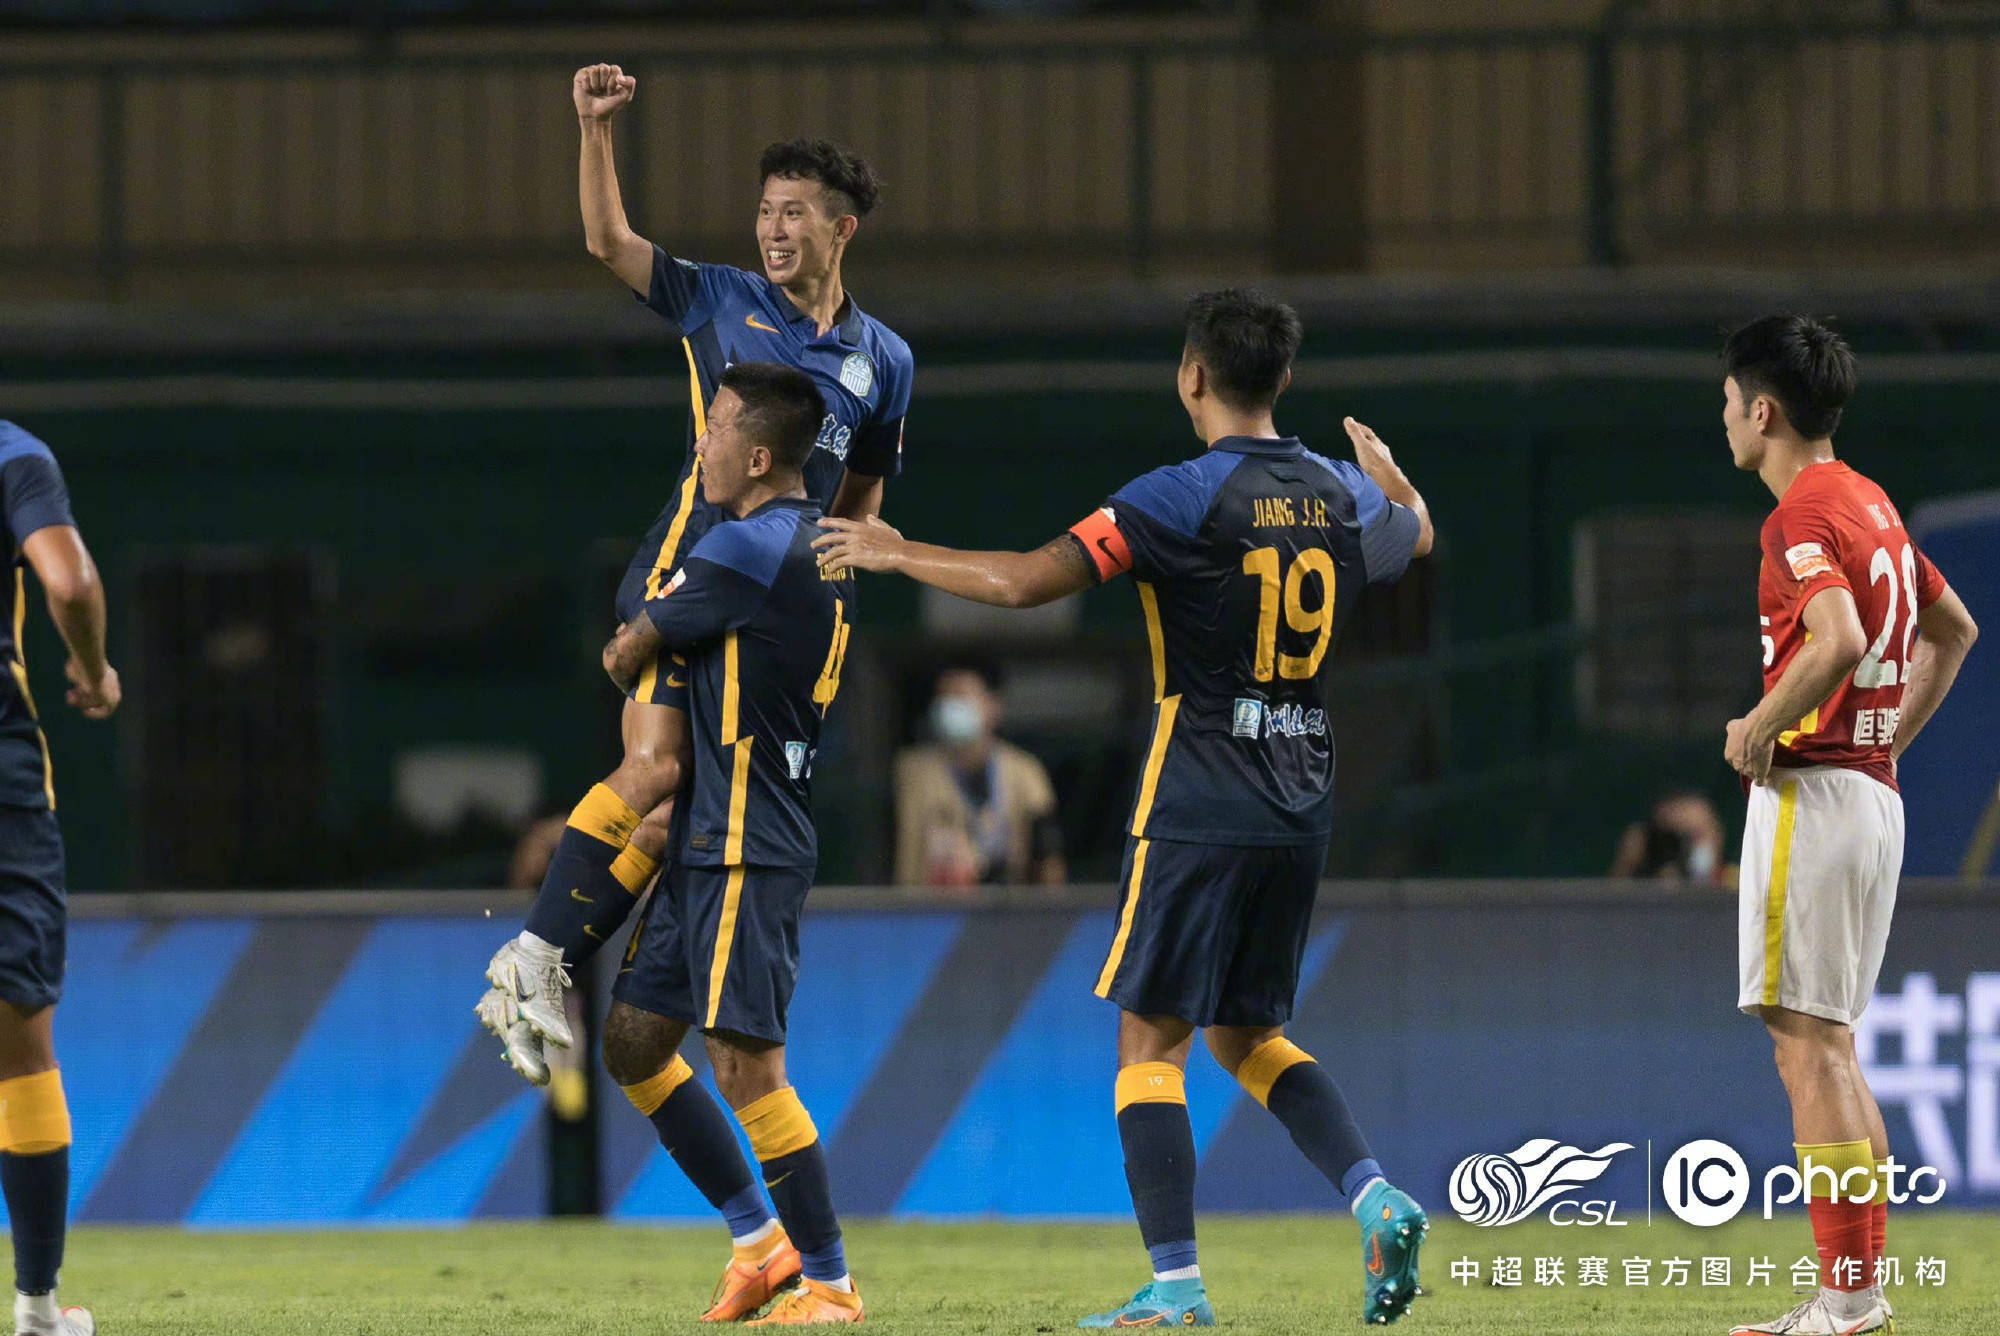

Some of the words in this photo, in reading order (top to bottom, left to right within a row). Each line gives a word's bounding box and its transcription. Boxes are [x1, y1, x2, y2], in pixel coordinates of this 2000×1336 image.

[1252, 497, 1295, 527] JIANG
[1302, 498, 1330, 527] J.H.
[1243, 546, 1336, 682] 19
